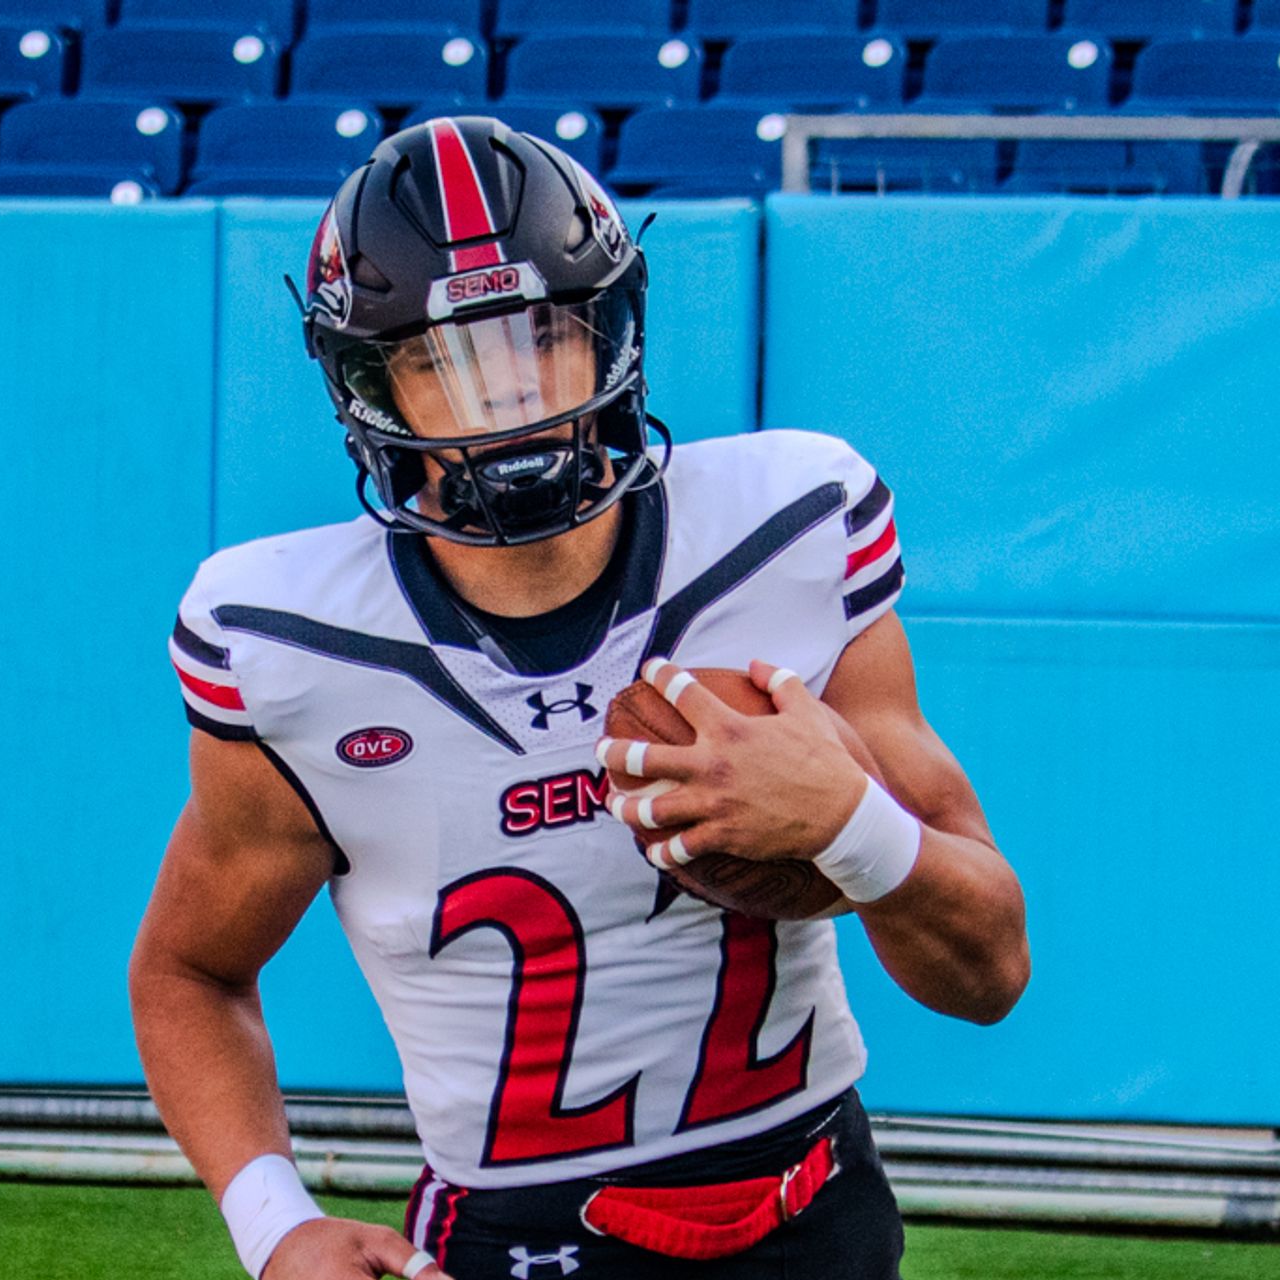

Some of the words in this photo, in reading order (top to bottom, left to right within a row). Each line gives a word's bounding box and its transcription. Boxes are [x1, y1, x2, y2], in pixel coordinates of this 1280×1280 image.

[447, 266, 520, 303] SEMO
[498, 456, 544, 475] Riddell
[353, 739, 392, 757] OVC
[500, 768, 610, 837] SEM
[429, 866, 816, 1169] 22
